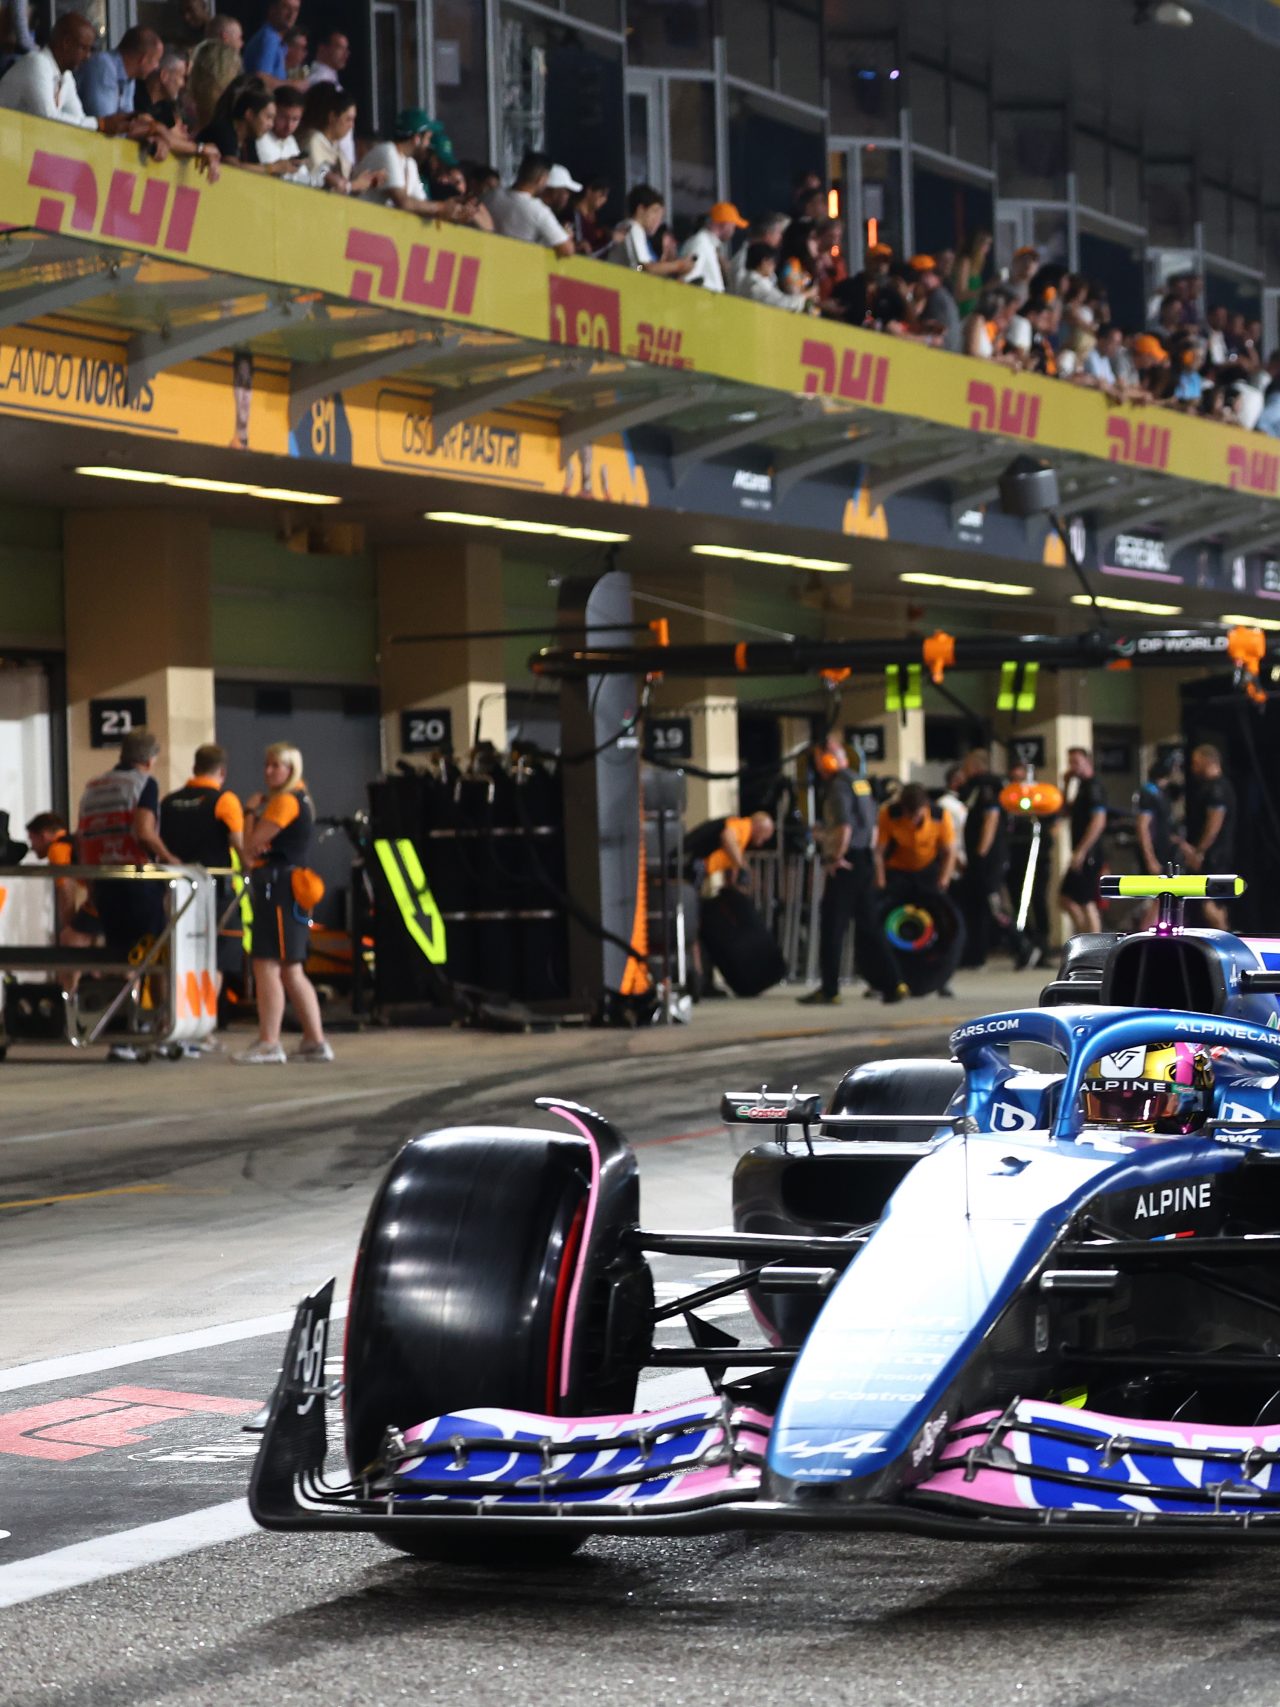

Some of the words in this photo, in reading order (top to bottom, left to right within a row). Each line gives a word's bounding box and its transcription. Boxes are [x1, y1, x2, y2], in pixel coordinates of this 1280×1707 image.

[1138, 639, 1161, 653] DP
[1164, 636, 1229, 652] WORLD
[101, 710, 133, 734] 21
[409, 719, 445, 741] 20
[653, 728, 683, 748] 19
[1079, 1080, 1166, 1092] ALPINE
[1134, 1182, 1211, 1220] ALPINE
